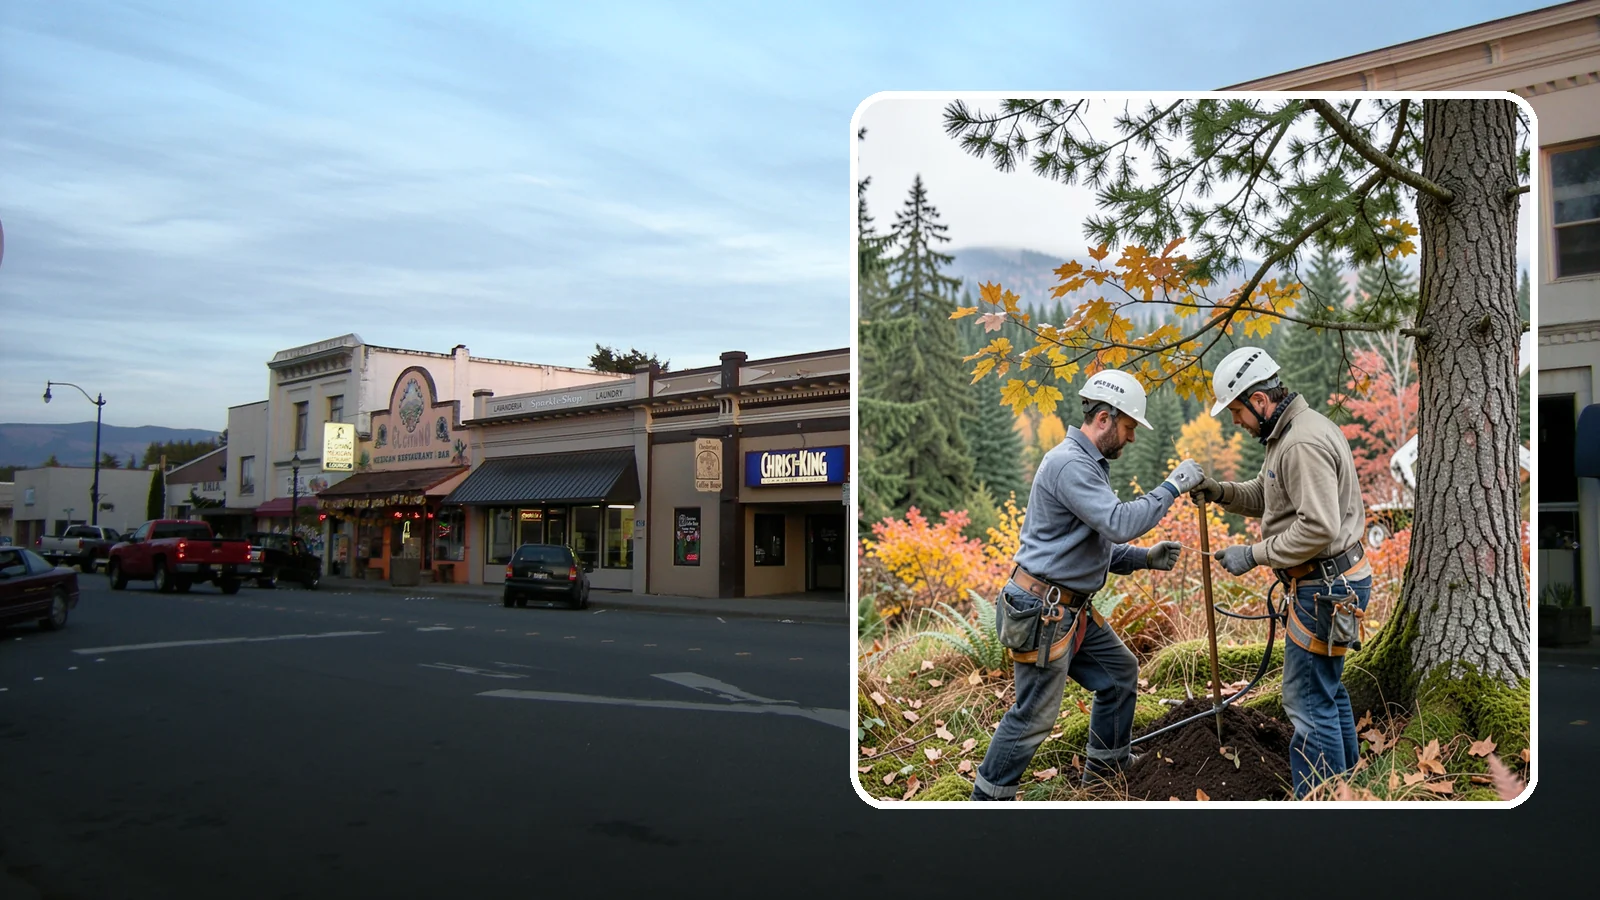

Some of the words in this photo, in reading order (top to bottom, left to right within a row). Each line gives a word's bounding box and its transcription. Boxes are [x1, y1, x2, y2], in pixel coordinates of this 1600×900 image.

[493, 402, 523, 413] LAVANDERIA
[530, 396, 561, 409] Sparkle
[561, 394, 583, 407] Shop
[595, 389, 624, 400] LAUNDRY
[373, 455, 396, 464] MEXICAN
[397, 451, 433, 462] RESTAURANT
[437, 450, 450, 459] BAR
[760, 451, 797, 478] CHRIST
[799, 449, 828, 476] KING
[696, 481, 709, 489] Coffee
